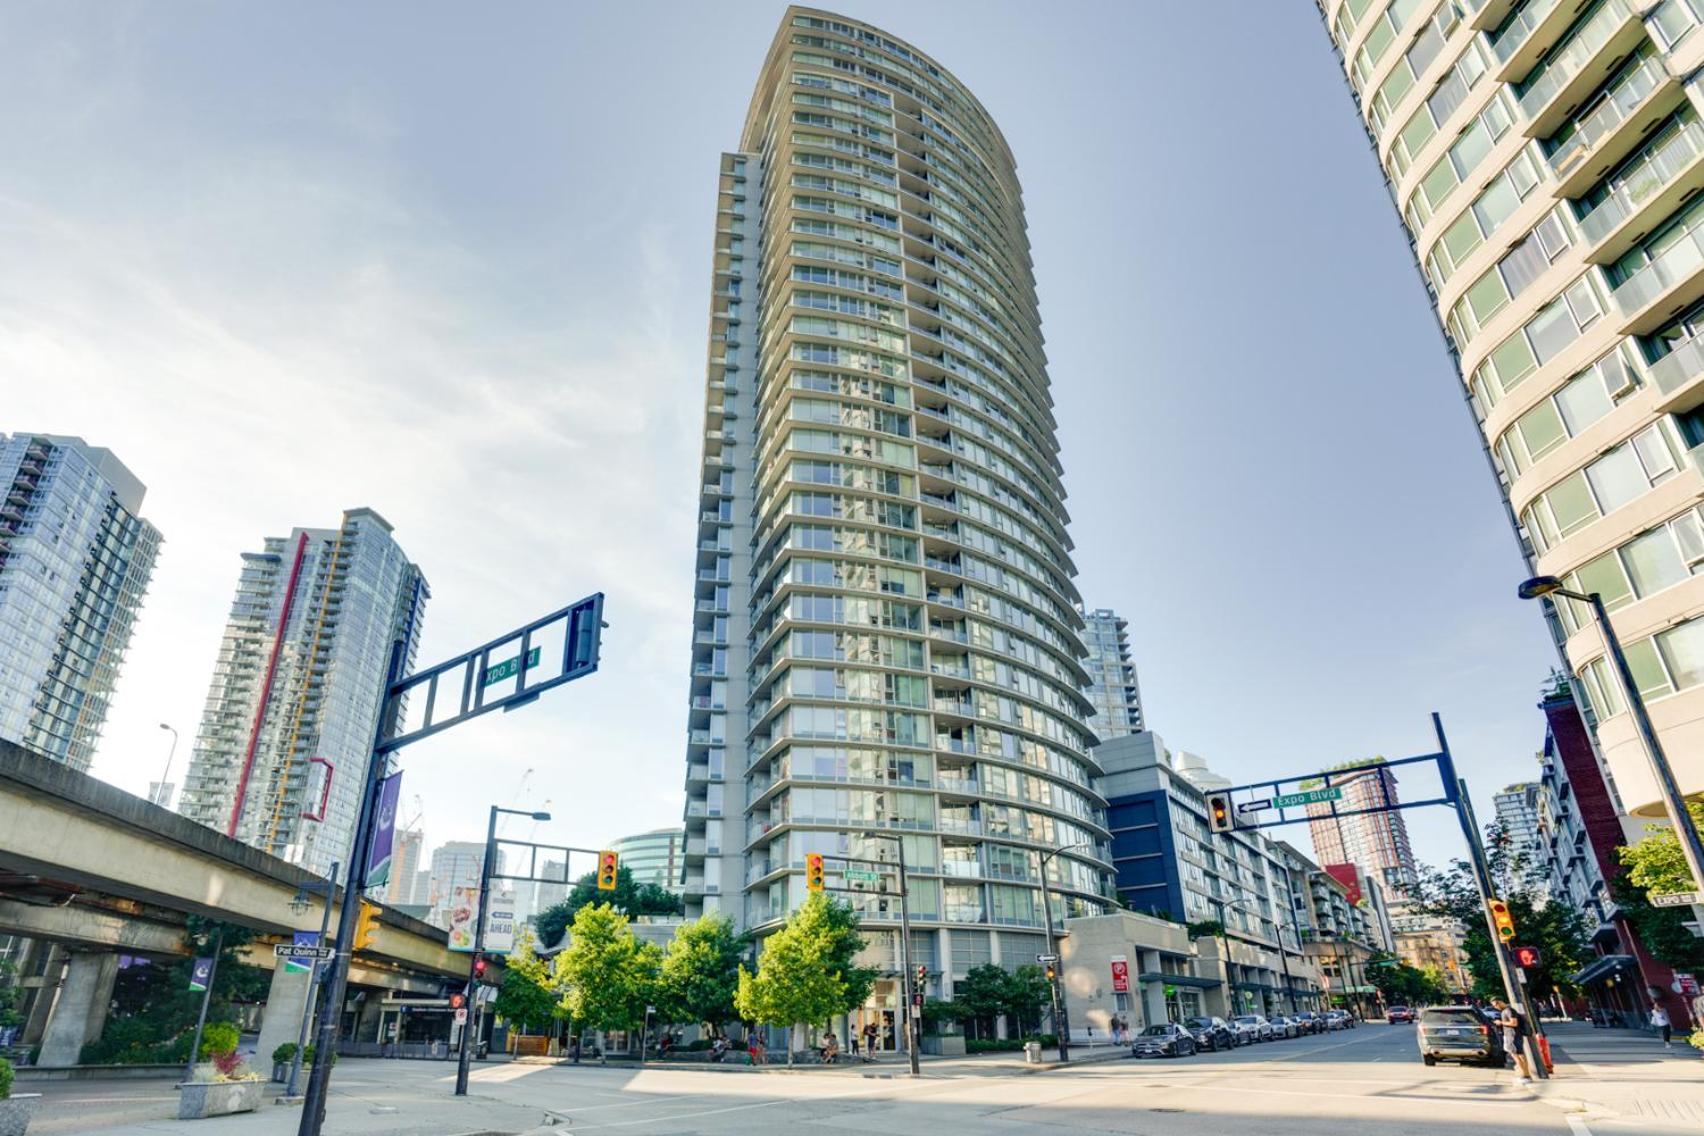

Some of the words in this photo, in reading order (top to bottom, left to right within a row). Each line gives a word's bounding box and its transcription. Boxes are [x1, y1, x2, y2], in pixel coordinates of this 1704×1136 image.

[486, 665, 506, 683] xpo
[1277, 794, 1305, 807] Expo
[1310, 789, 1336, 801] Blvd
[490, 924, 512, 934] AHEAD
[277, 946, 292, 955] Pat
[293, 947, 318, 957] Quinn
